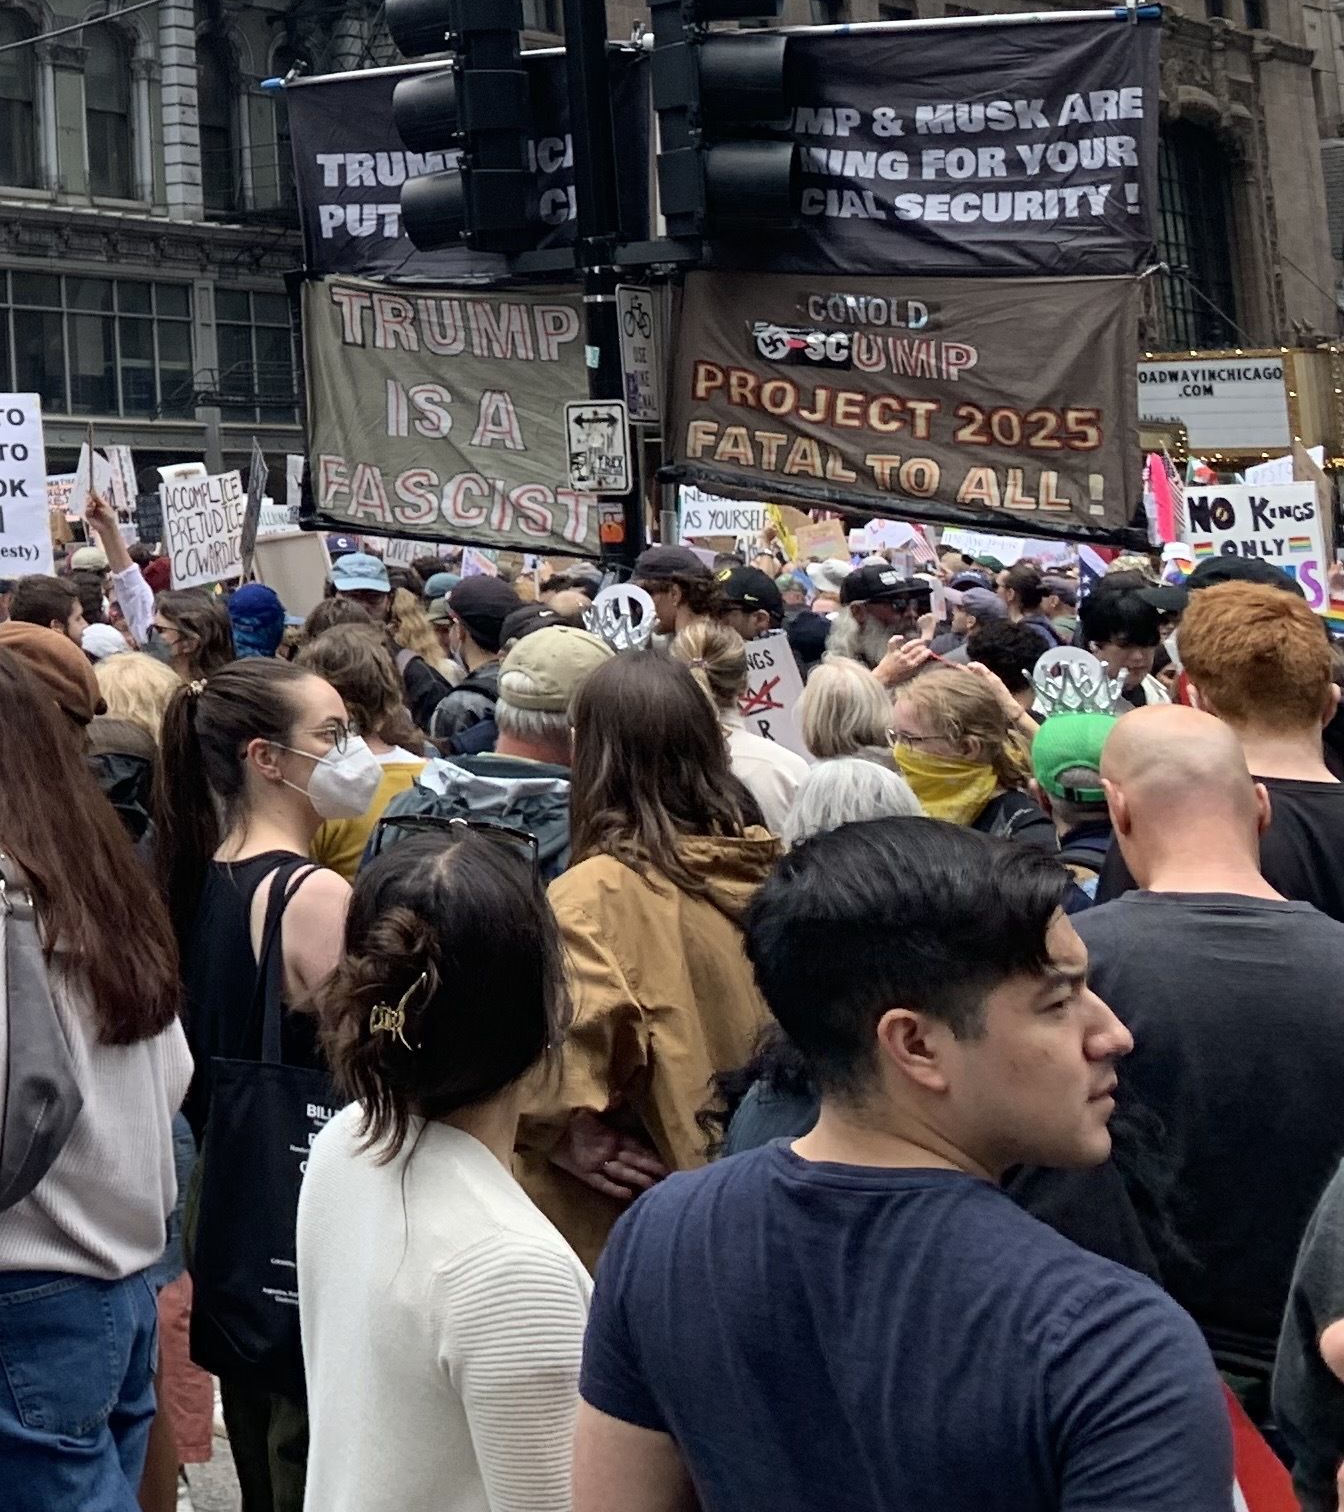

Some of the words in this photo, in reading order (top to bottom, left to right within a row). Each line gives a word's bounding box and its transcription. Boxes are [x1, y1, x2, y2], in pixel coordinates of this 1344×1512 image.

[872, 106, 905, 137] &
[916, 99, 1050, 135] MUSK
[1057, 87, 1144, 127] ARE
[921, 147, 1007, 180] FOR
[1016, 135, 1139, 176] YOUR
[800, 189, 887, 220] CIAL
[894, 184, 1111, 223] SECURITY
[329, 287, 580, 362] TRUMP
[1138, 367, 1282, 384] OADWAYINCHICAGO
[1178, 385, 1214, 398] .COM
[385, 379, 453, 439] IS
[469, 389, 526, 450] A
[691, 360, 941, 440] PROJECT
[953, 403, 1103, 451] 2025
[686, 419, 858, 484] FATAL
[865, 453, 941, 497] TO
[956, 465, 1072, 512] ALL
[164, 475, 239, 513] ACCOMPLICE
[316, 454, 599, 544] FASCIST
[1187, 495, 1235, 534] NO
[1248, 495, 1315, 532] KINGS
[168, 502, 244, 551] PREJUDICE
[684, 510, 702, 530] AS
[708, 509, 769, 531] YOURSELF
[173, 535, 243, 582] COWARDIC
[1220, 539, 1285, 558] ONLY
[746, 649, 775, 672] NGS
